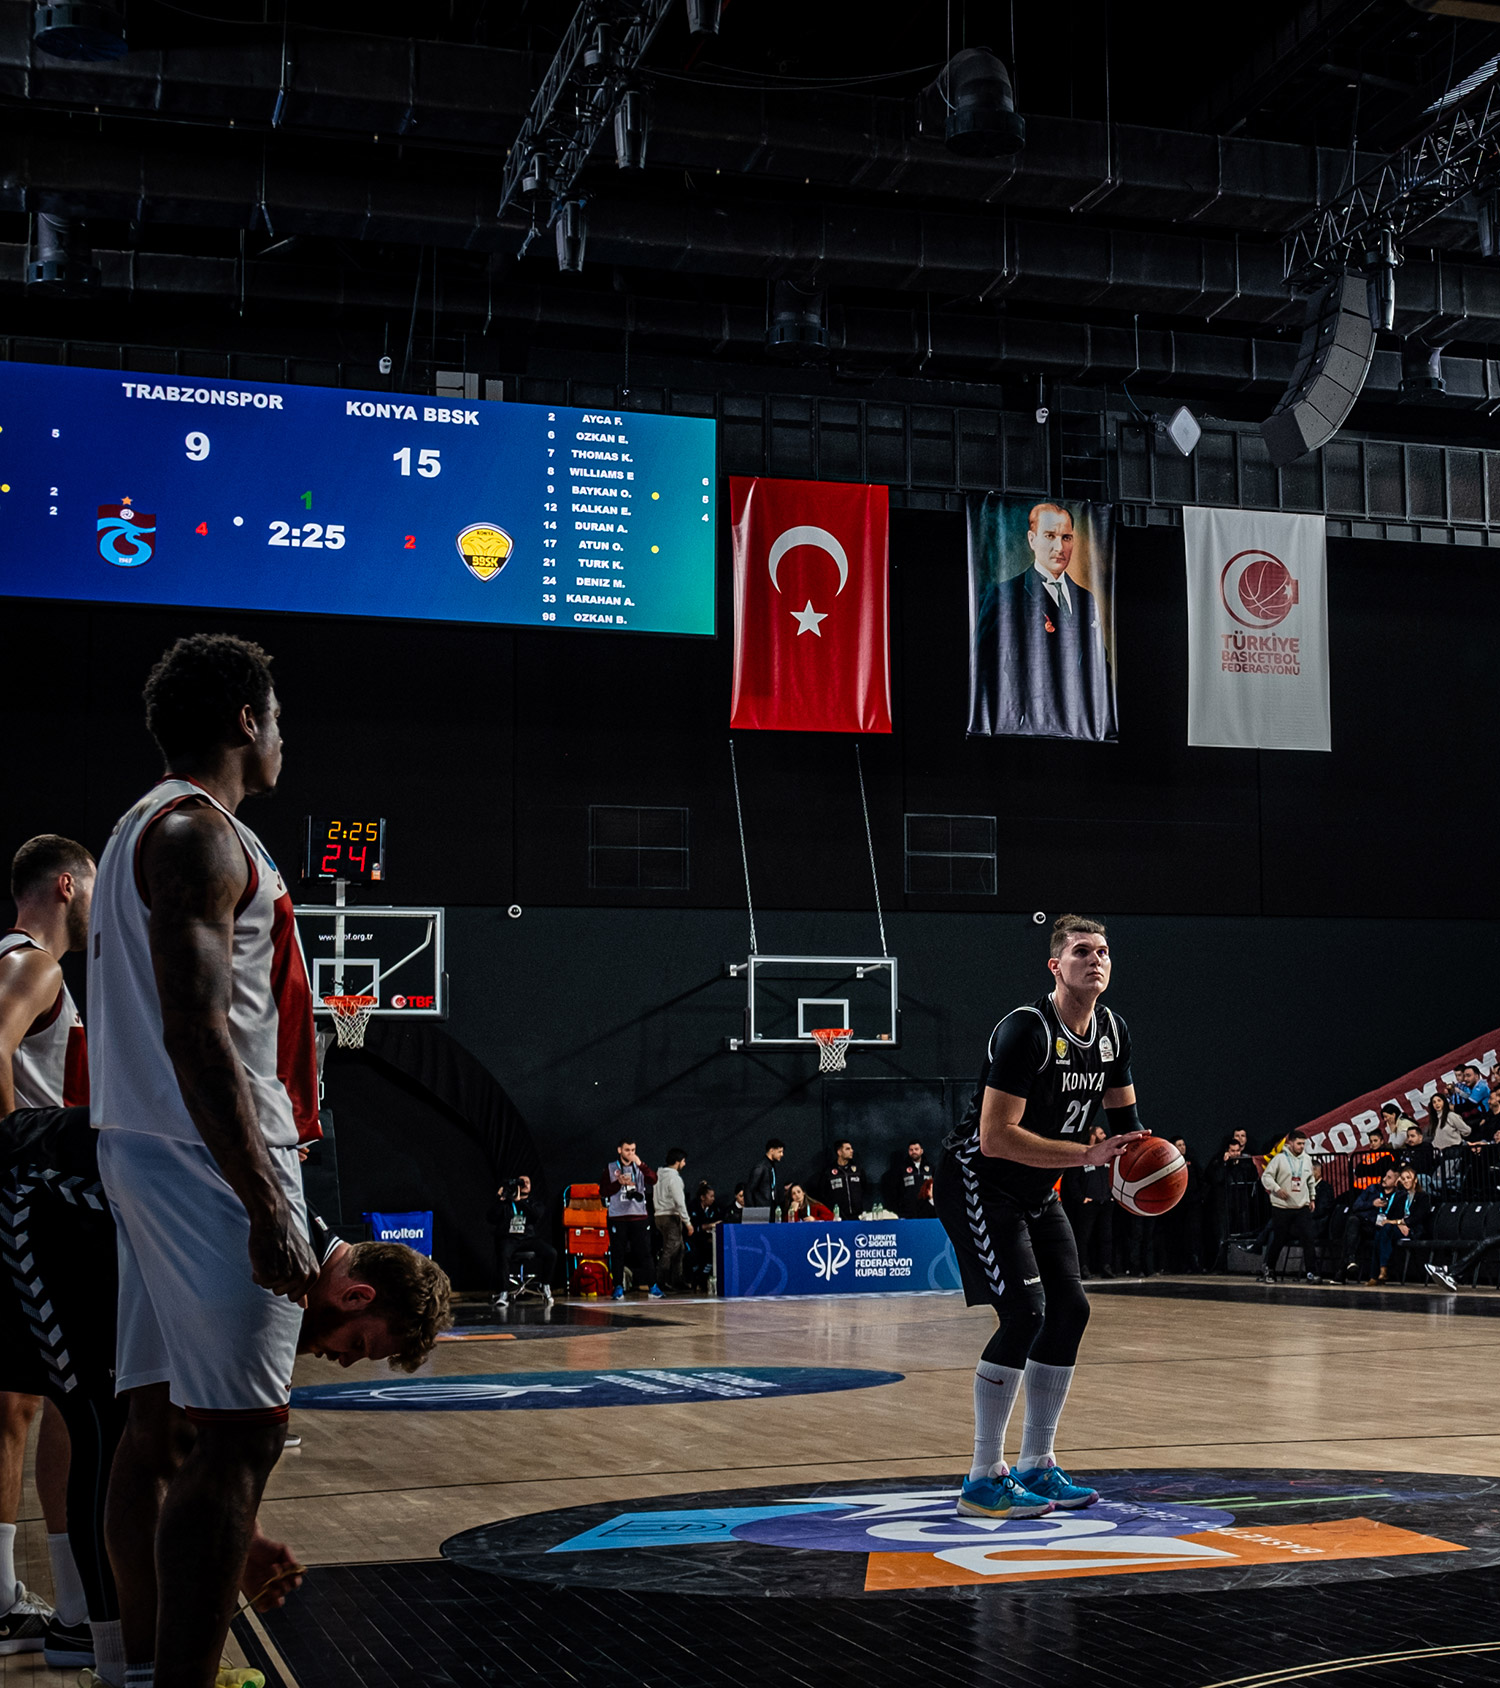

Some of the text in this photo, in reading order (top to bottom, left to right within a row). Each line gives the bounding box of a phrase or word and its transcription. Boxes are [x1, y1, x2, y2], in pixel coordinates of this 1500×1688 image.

[122, 382, 283, 410] TRABZONSPOR
[346, 401, 480, 426] KONYA BBSK
[548, 412, 623, 426] 2 AYCA F.
[51, 428, 60, 438] 5
[547, 430, 629, 444] 6 OZKAN E.
[185, 431, 210, 461] 9
[392, 447, 441, 478] 15
[547, 448, 634, 463] 7 THOMAS K.
[547, 466, 635, 481] 8 WILLIAMS E
[702, 477, 710, 486] 6
[50, 486, 58, 496] 2
[547, 484, 632, 499] 9 BAYKAN O.
[300, 490, 313, 510] 1
[702, 495, 710, 504] 5
[49, 506, 58, 516] 2
[543, 502, 632, 516] 12 KALKAN E.
[701, 513, 710, 522] 4
[195, 522, 208, 536] 4
[543, 520, 628, 534] 14 DURAN A.
[268, 521, 346, 550] 2:25
[404, 535, 416, 550] 2
[543, 539, 624, 552] 17 ATUN O.
[543, 557, 625, 570] 21 TURK K.
[542, 576, 626, 589] 24 DENIZ M.
[542, 593, 636, 607] 33 KARAHAN A.
[542, 612, 628, 625] 98 OZKAN B.
[1221, 630, 1300, 653] TÜRKİYE
[1221, 650, 1300, 666] BASKETBOL
[1221, 663, 1300, 676] FEDERASYONU
[327, 820, 378, 842] 2:25
[321, 844, 367, 873] 24
[406, 995, 434, 1008] TBF
[1061, 1071, 1106, 1093] KONYA
[1060, 1099, 1092, 1134] 21
[381, 1228, 425, 1240] molten
[855, 1249, 898, 1259] ERKEKLER
[855, 1257, 913, 1268] FEDERASYON
[855, 1267, 911, 1278] KUPASI 2025
[1181, 1520, 1327, 1555] BASKETBOL
